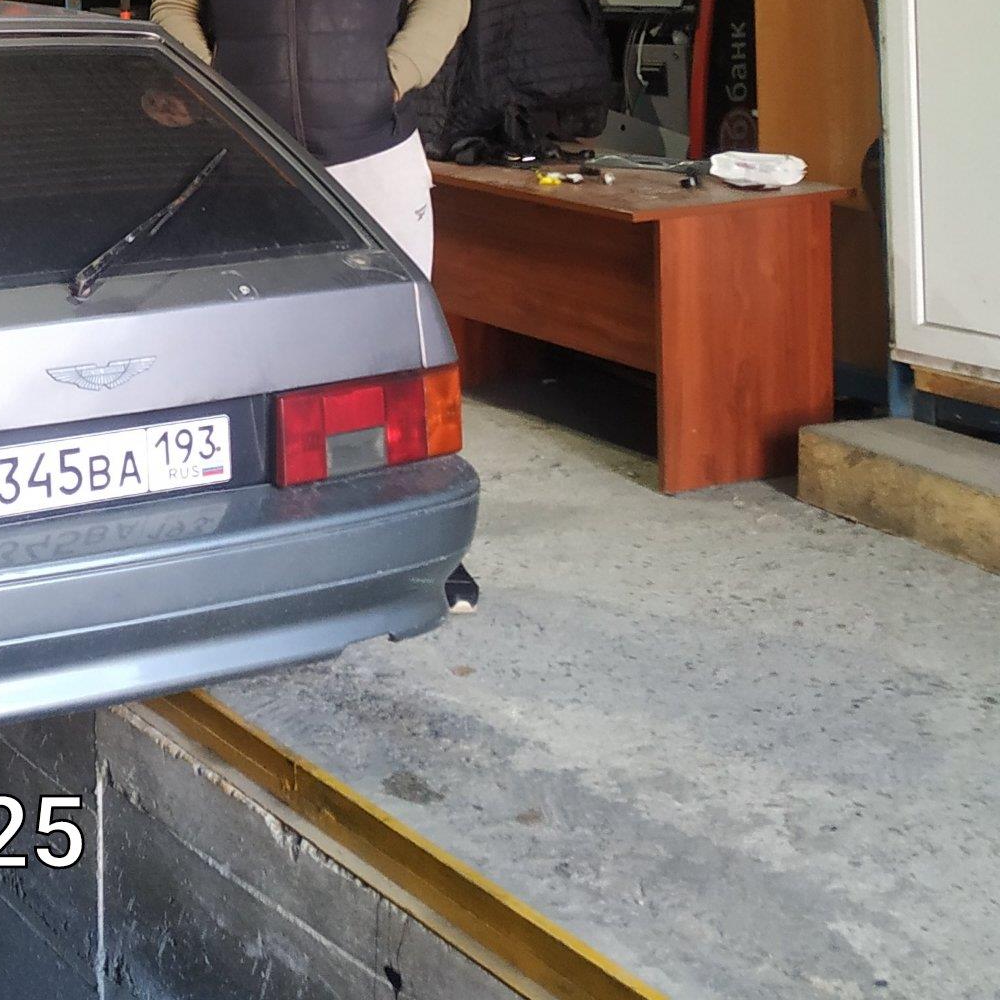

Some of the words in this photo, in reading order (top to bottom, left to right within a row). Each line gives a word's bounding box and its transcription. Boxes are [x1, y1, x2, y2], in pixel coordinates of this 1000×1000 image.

[725, 21, 748, 103] банк
[155, 425, 217, 466] 193
[168, 465, 200, 480] RUS
